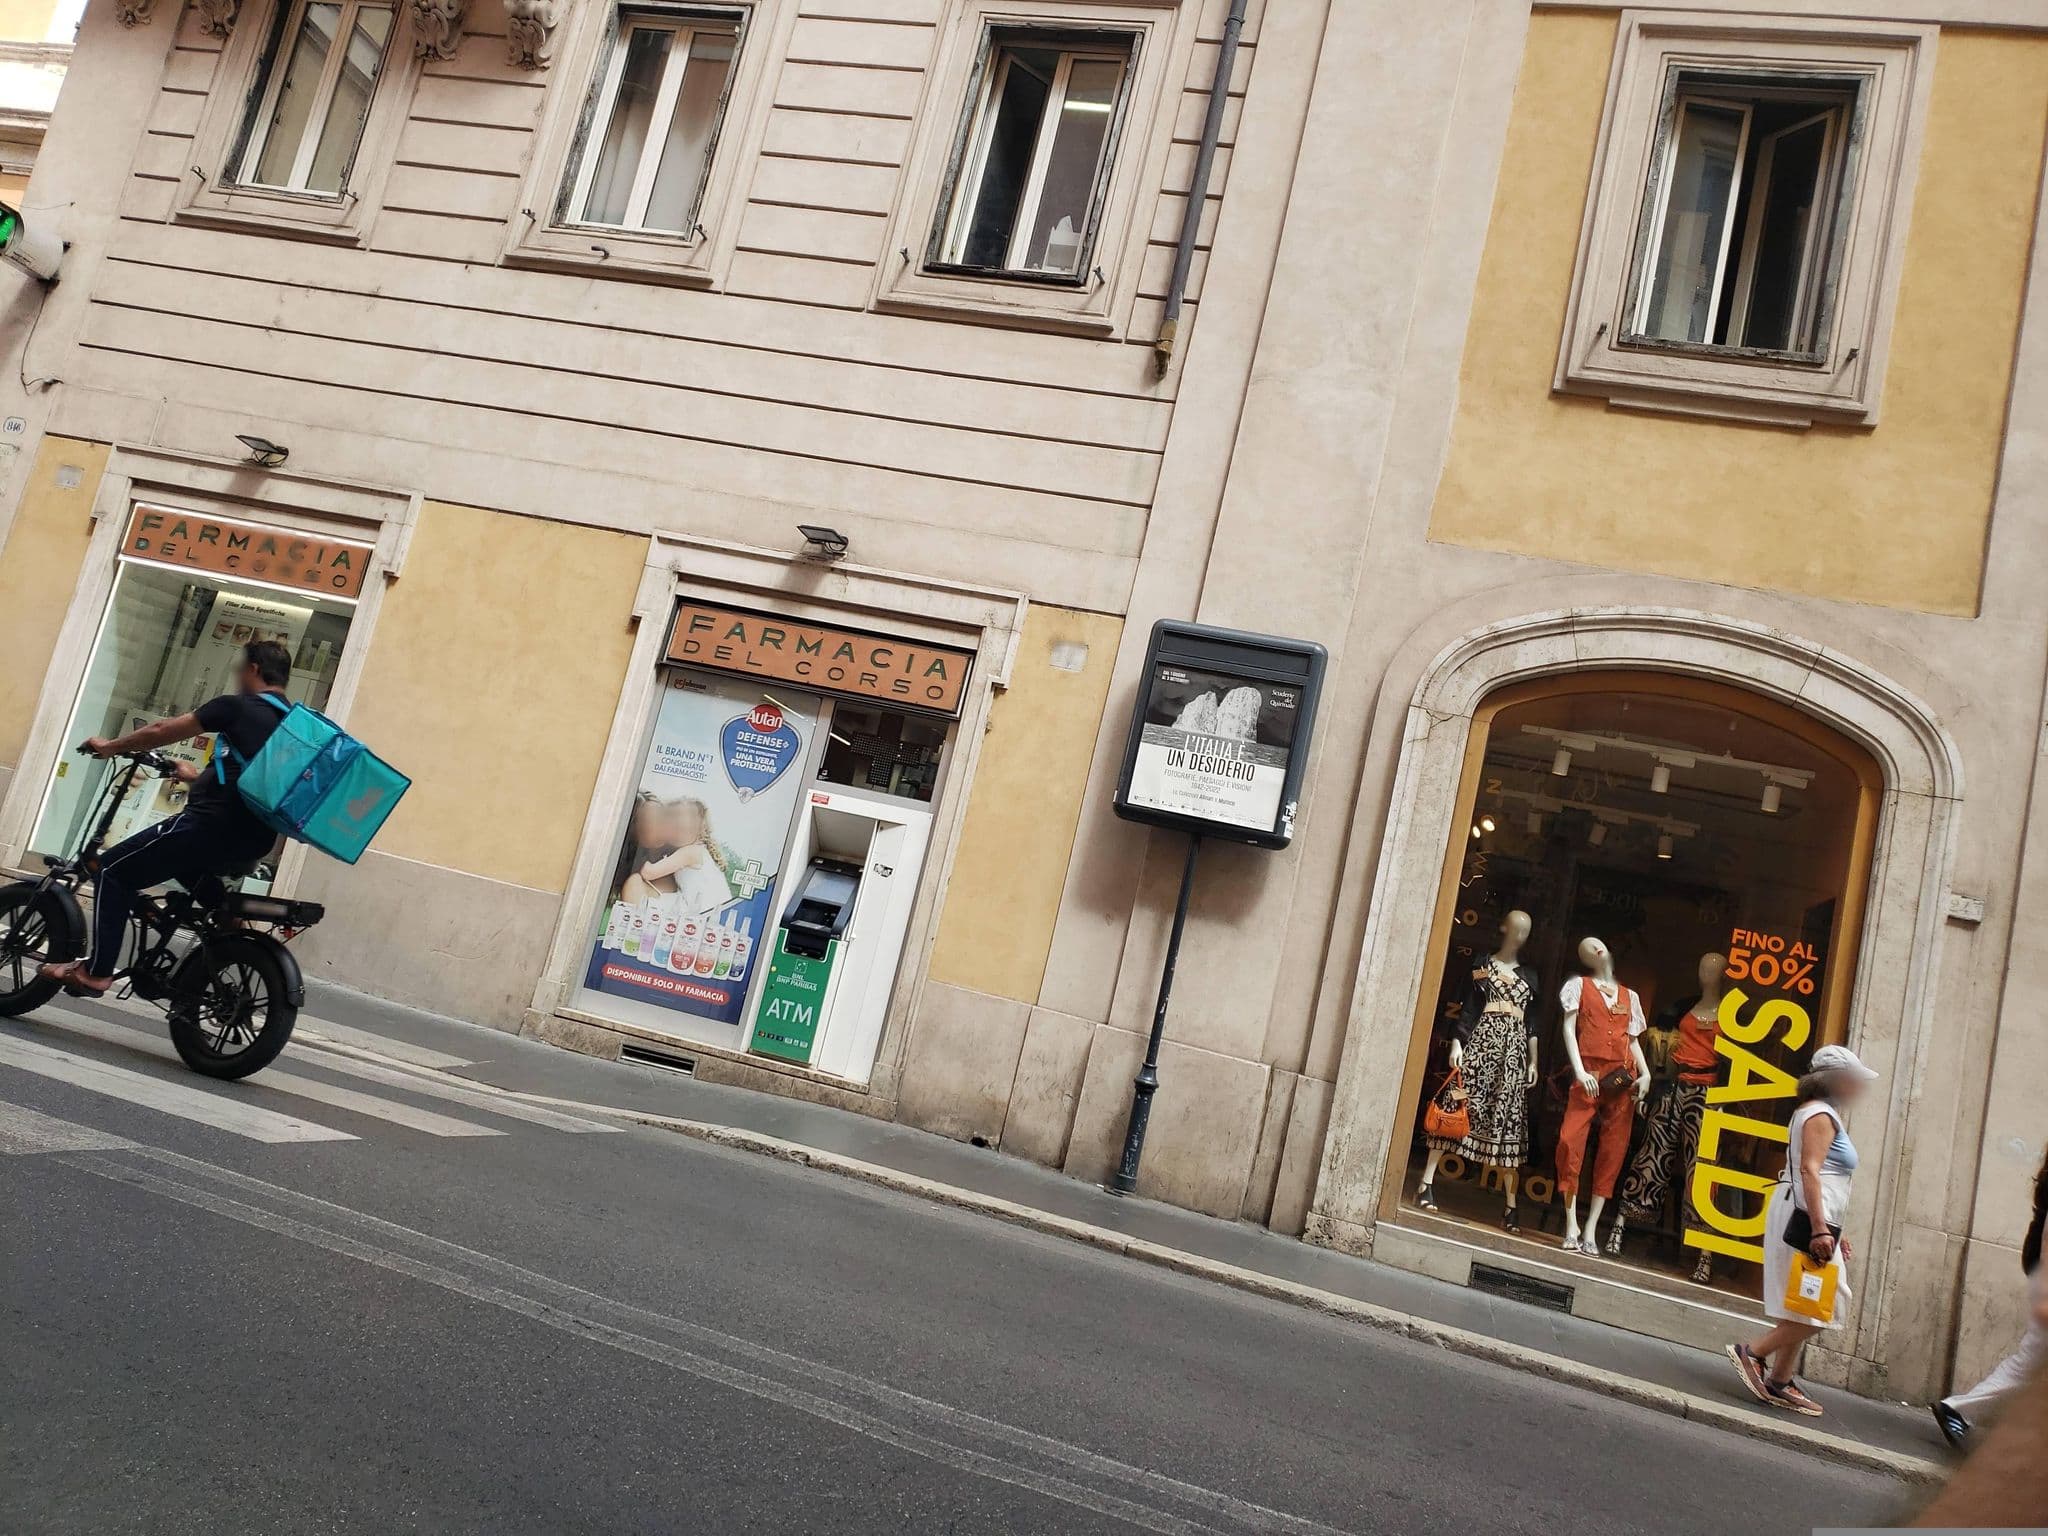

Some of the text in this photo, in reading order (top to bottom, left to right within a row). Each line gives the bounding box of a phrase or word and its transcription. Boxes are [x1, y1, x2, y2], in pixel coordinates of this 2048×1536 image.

[140, 514, 352, 570] FARMACIA
[135, 537, 348, 588] DEL COSO
[688, 614, 948, 681] FARMACIA
[683, 639, 944, 700] DEL CORSO
[745, 709, 784, 729] Autan
[656, 745, 664, 754] IL
[664, 746, 696, 760] BRAND
[661, 757, 705, 772] CONSIGLIATO
[730, 758, 778, 774] PROTEZIONE
[735, 752, 776, 767] UNA VERA
[1166, 749, 1256, 782] UN DESIDERIO
[1731, 928, 1819, 962] FINO AL
[606, 967, 725, 1002] DISPONIBILE SOLO IN FARMACIA
[1724, 947, 1815, 995] 50%
[765, 997, 814, 1027] ATM
[1683, 987, 1812, 1265] SALDI
